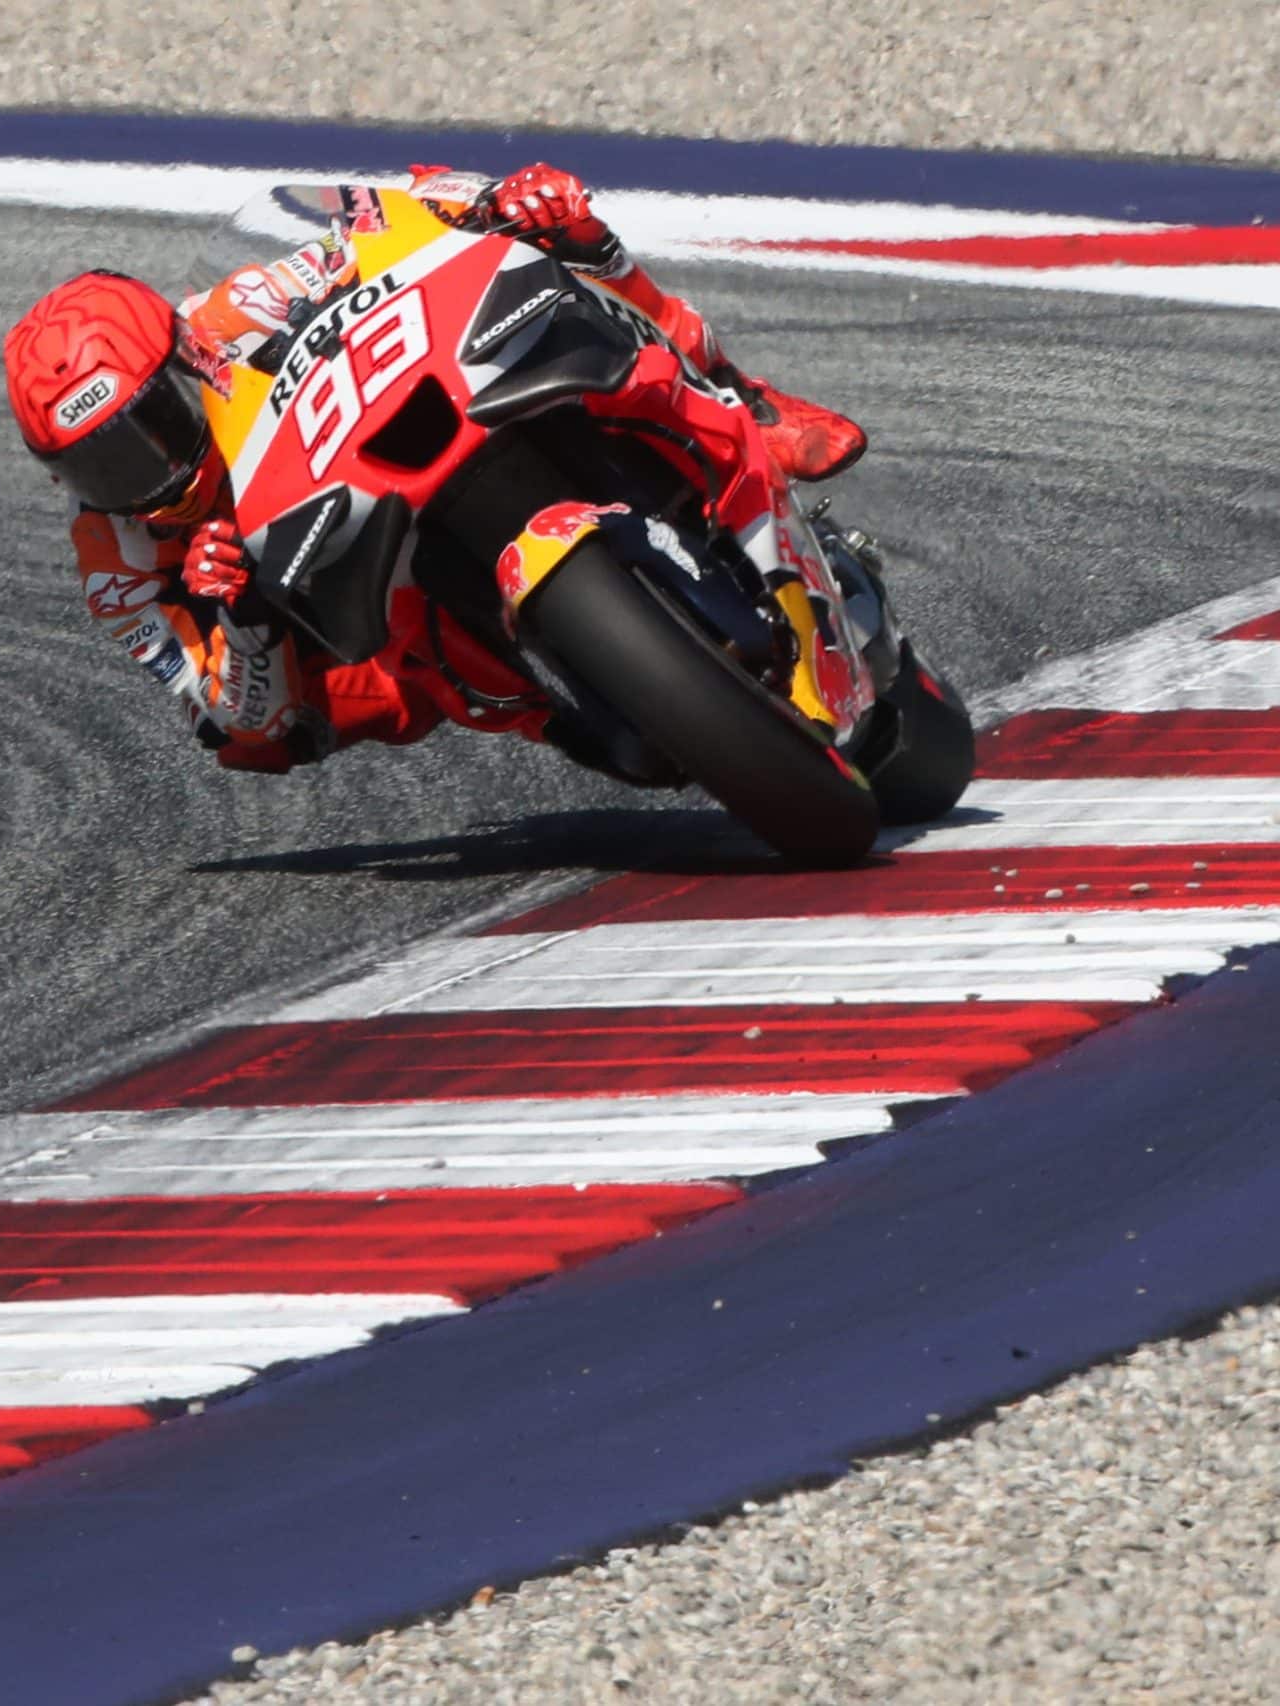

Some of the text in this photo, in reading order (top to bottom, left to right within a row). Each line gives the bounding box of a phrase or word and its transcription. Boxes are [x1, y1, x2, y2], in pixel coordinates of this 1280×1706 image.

[270, 273, 405, 418] REPSOL
[470, 287, 558, 350] HONDA
[61, 380, 111, 425] SHOEI
[293, 285, 432, 482] 93
[280, 498, 336, 588] HONDA
[240, 652, 270, 730] REPSO
